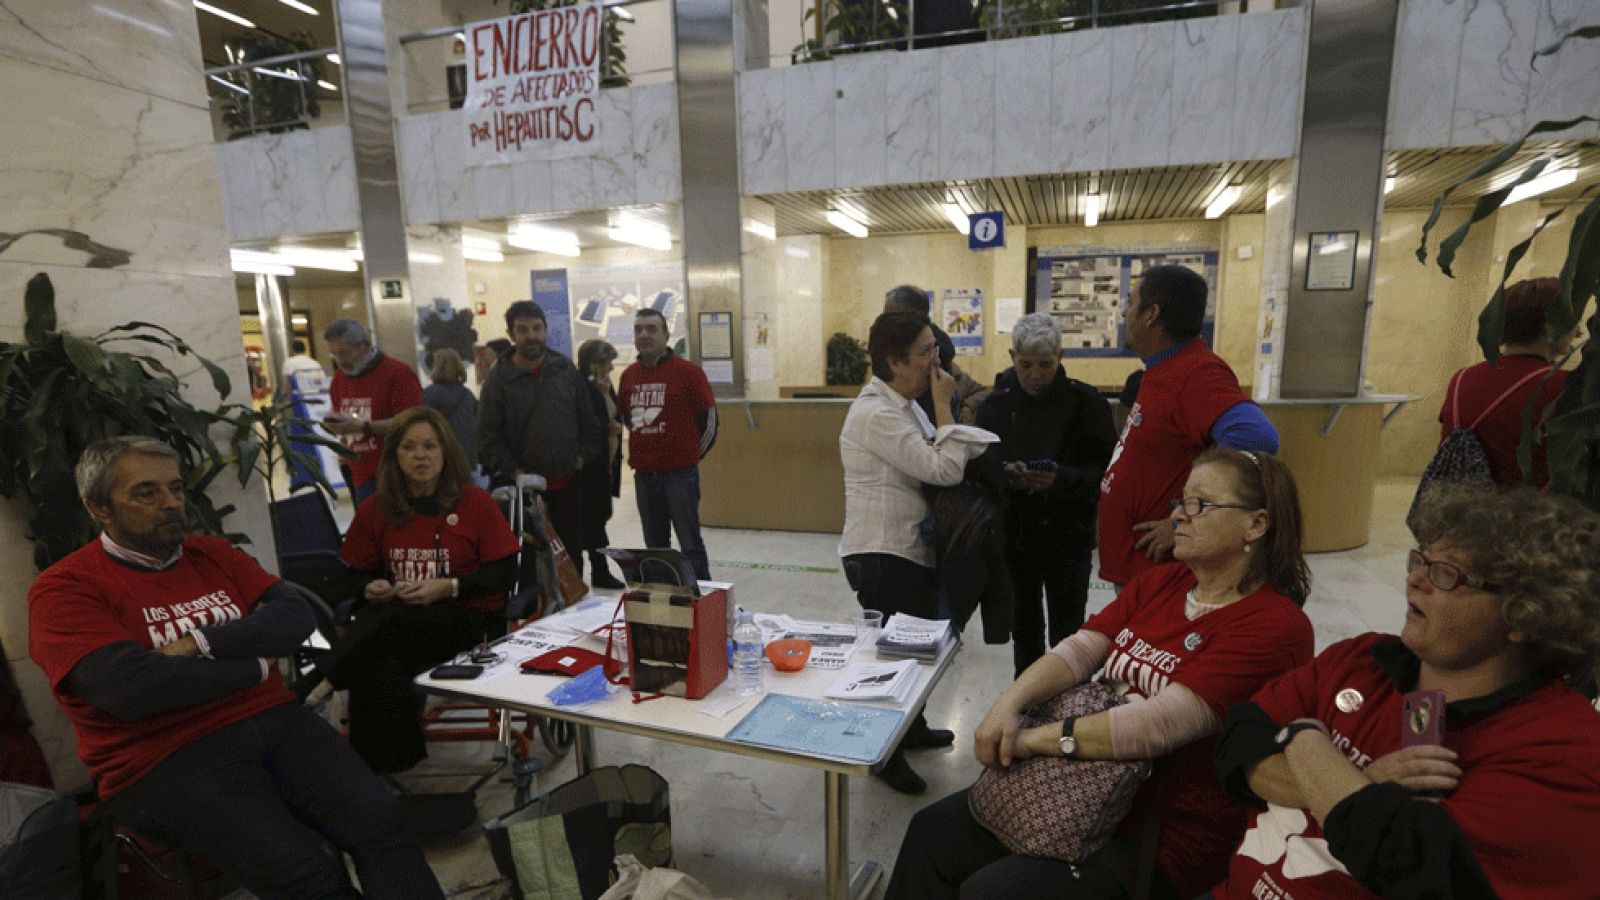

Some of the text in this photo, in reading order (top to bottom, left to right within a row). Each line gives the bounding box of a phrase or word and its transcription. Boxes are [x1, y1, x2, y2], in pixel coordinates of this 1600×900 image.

[472, 6, 599, 81] ENCIERRO
[481, 70, 595, 108] DE AFECTADOS
[574, 98, 594, 142] C
[142, 606, 171, 623] LOS
